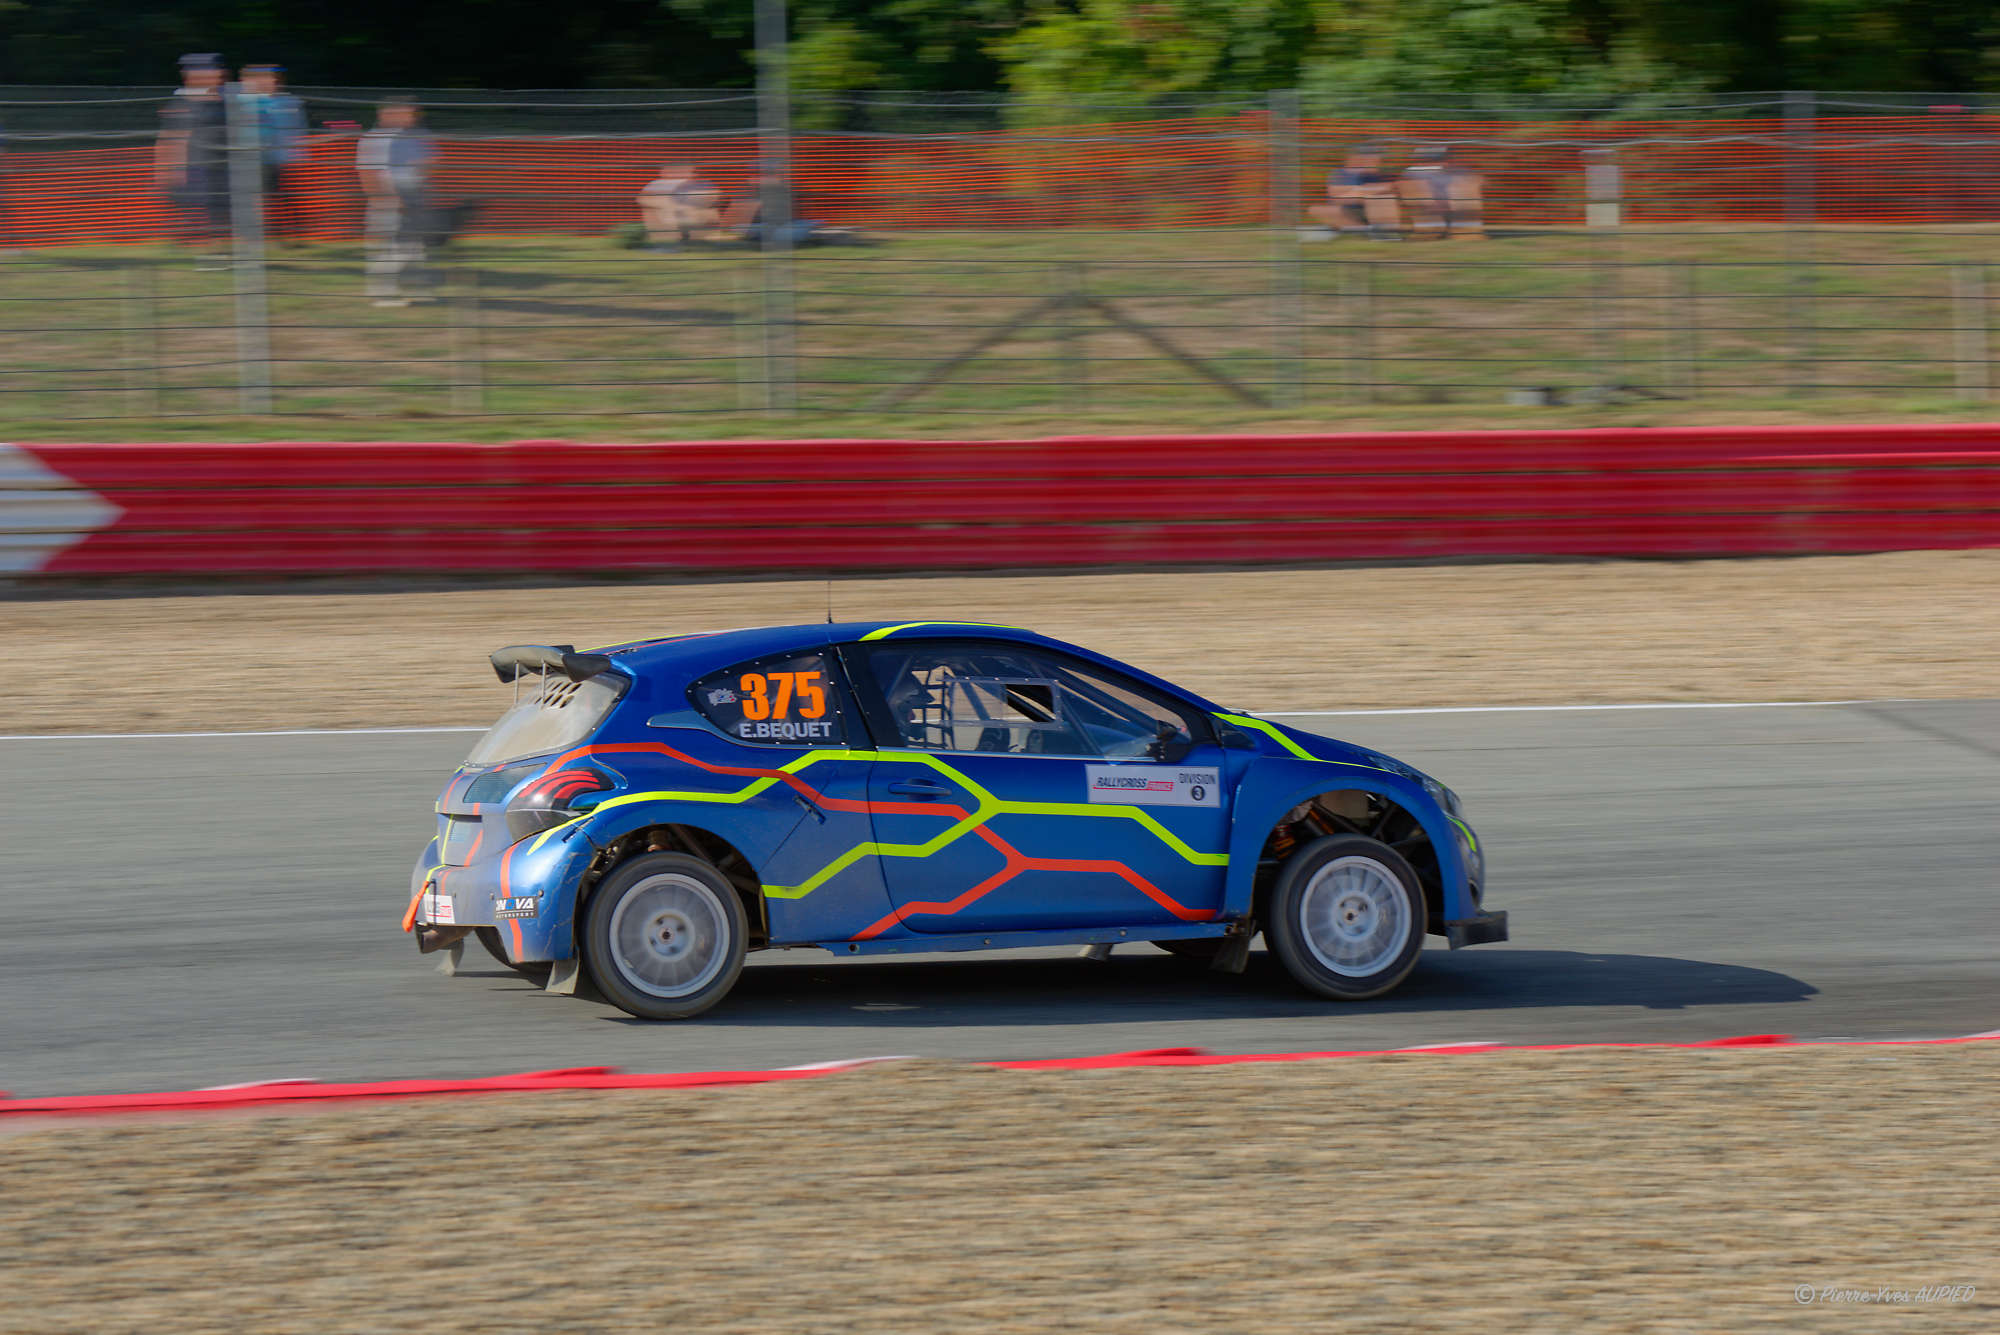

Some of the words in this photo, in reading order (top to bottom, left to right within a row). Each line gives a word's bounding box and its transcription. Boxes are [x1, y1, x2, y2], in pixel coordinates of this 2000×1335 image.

[740, 671, 826, 720] 375
[739, 721, 832, 740] E.BEQUET
[1096, 777, 1148, 788] RALLYCROSS
[1179, 773, 1216, 785] DIVISION
